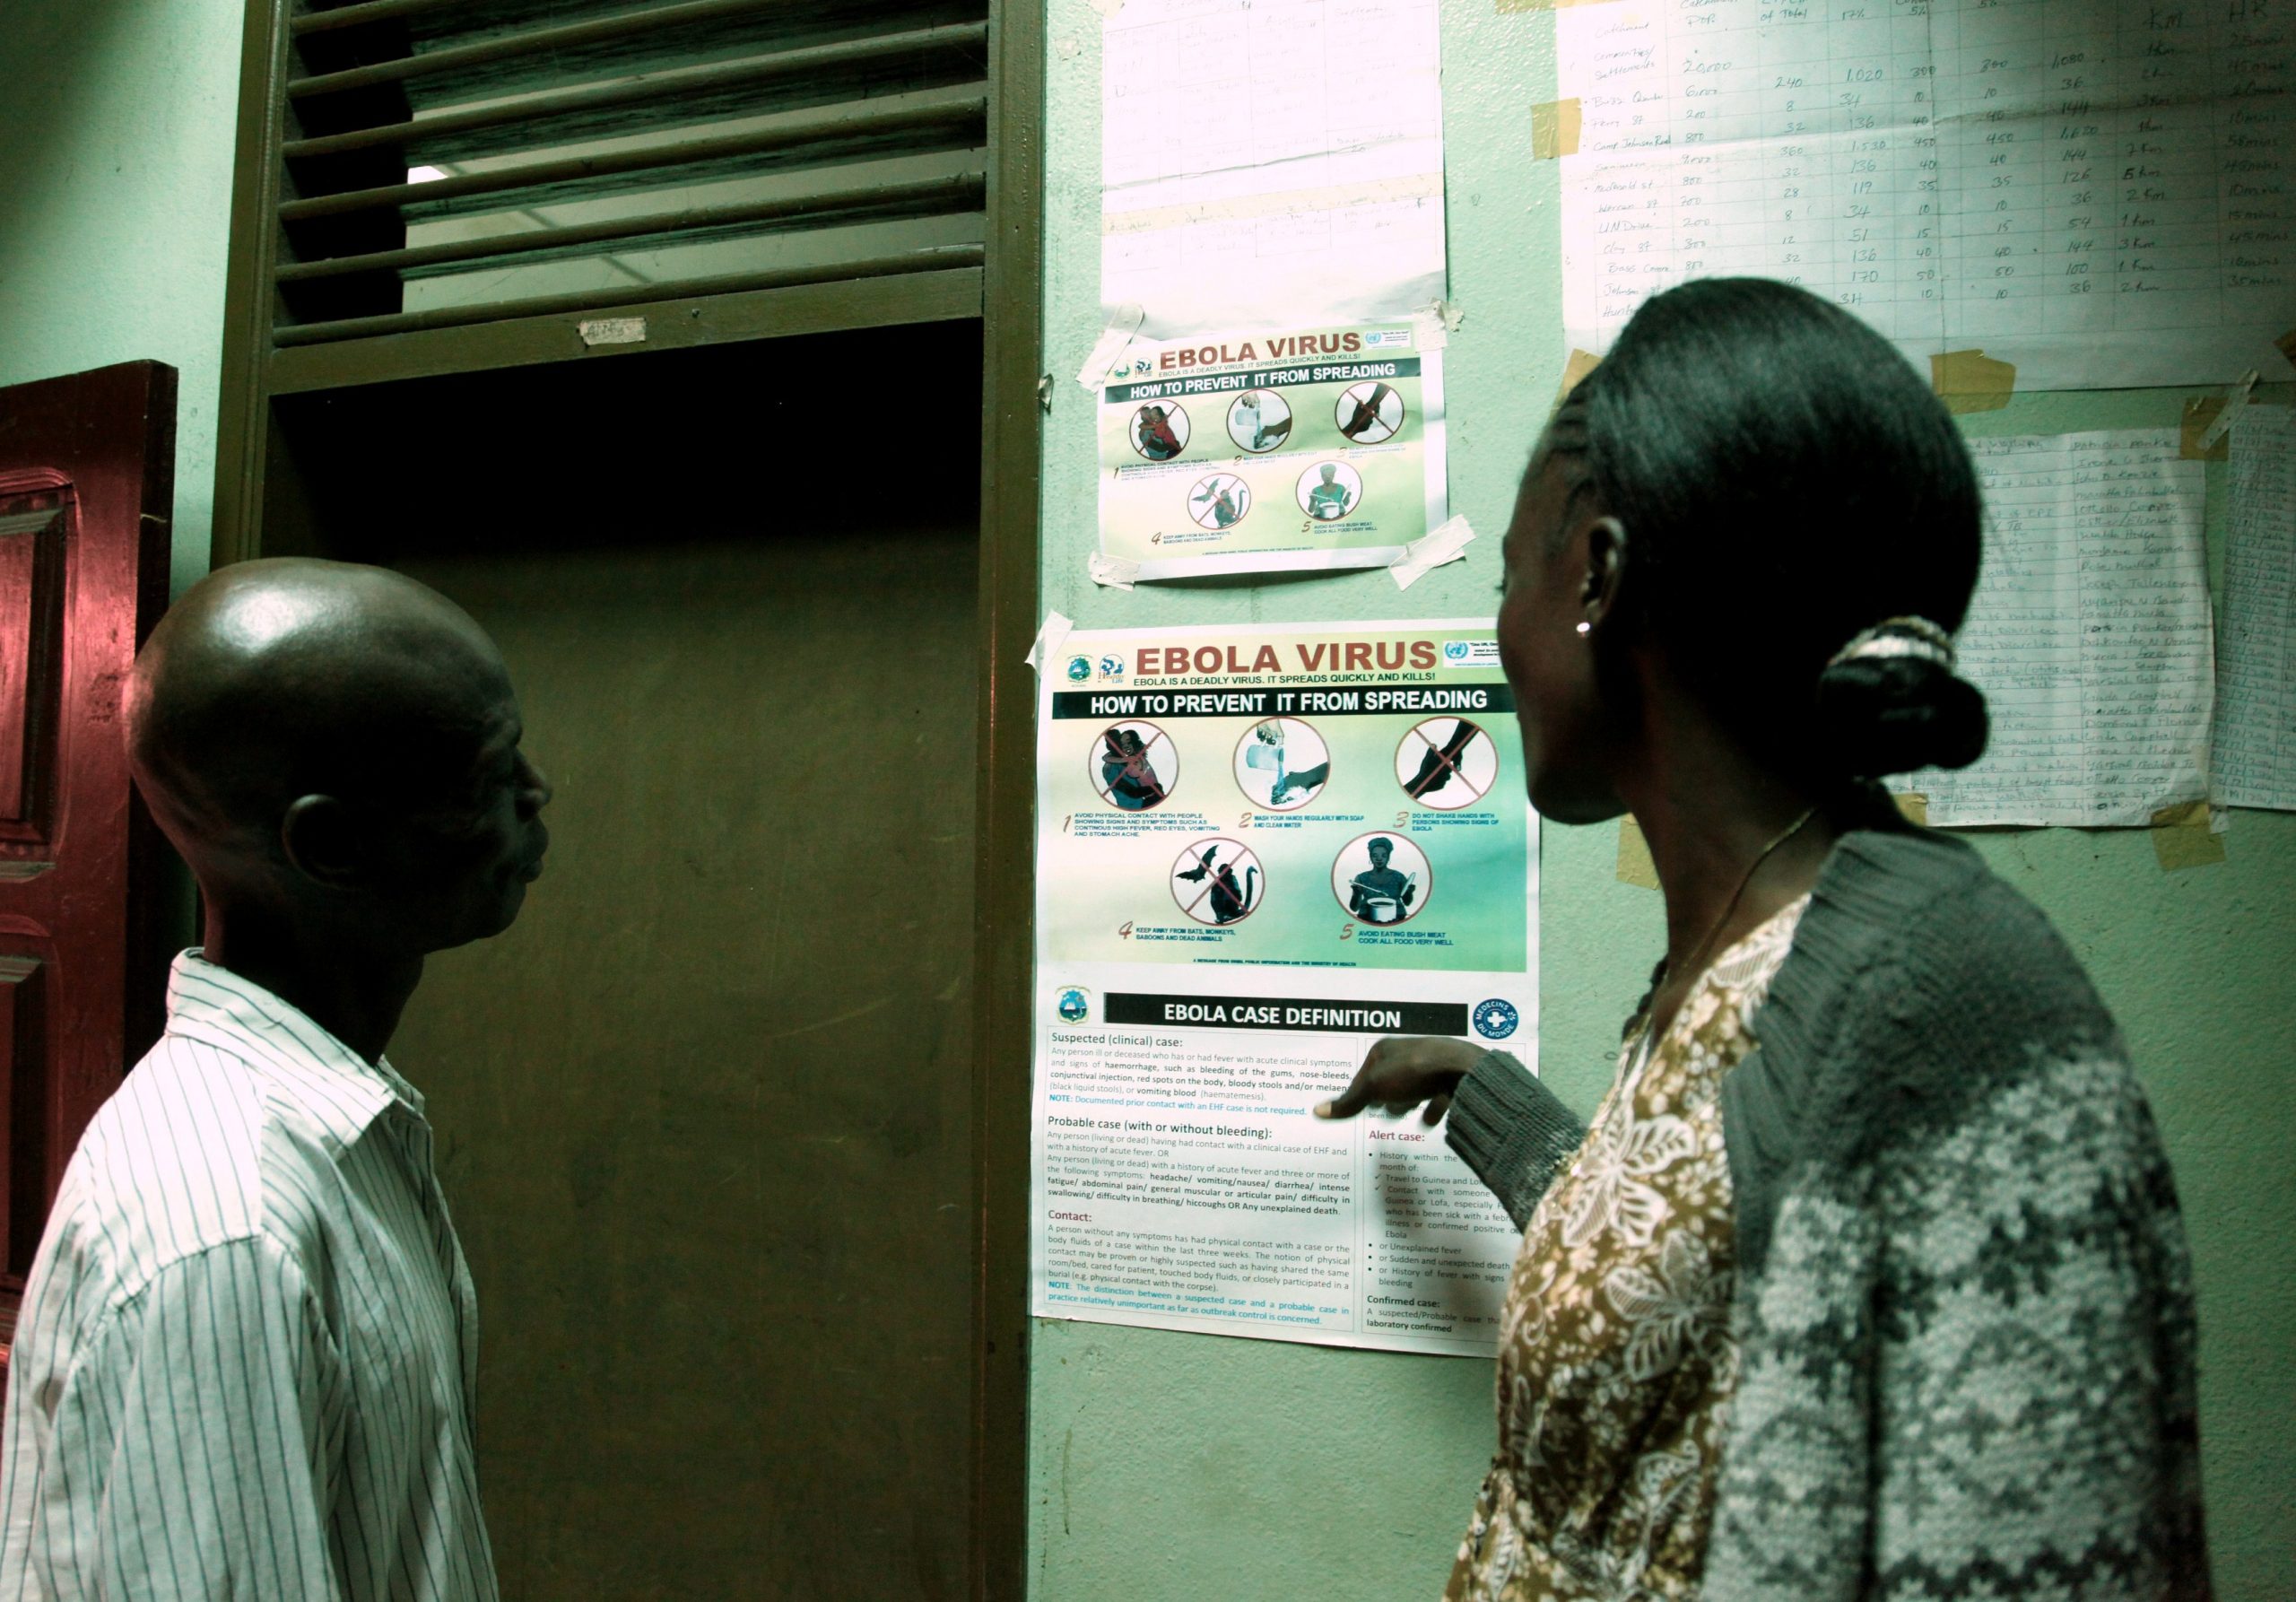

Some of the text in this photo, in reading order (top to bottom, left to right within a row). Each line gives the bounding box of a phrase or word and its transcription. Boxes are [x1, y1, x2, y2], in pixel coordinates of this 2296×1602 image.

[1775, 77, 1803, 89] 240
[1854, 182, 1872, 195] 119
[1852, 249, 1876, 263] 136
[1851, 270, 1878, 283] 170
[1160, 343, 1257, 370] EBOLA
[1266, 332, 1361, 360] VIRUS
[1159, 370, 1180, 378] EBOLA
[1290, 355, 1319, 363] QUICKLY
[1130, 362, 1396, 399] HOW TO PREVENT IT FROM SPREADING
[1136, 644, 1282, 675] EBOLA
[1295, 640, 1436, 673] VIRUS
[1134, 672, 1435, 687] EBOLA IS A DEADLY VIRUS. IT SPREADS QUICKLY AND KILLS!
[1091, 690, 1487, 715] HOW TO PREVENT IT FROM SPREADING
[1239, 812, 1252, 828] 2
[1393, 811, 1409, 828] 3
[1118, 921, 1133, 939] 4
[1339, 924, 1354, 940] 5
[1164, 1002, 1400, 1030] EBOLA CASE DEFINITION
[1477, 1023, 1515, 1038] DU MONDE
[1051, 1032, 1182, 1048] Suspected (clinical) case:
[1048, 1092, 1306, 1117] NOTE: Documented prior contact with an EHF case is not required.
[1048, 1114, 1271, 1140] Probable case (with or without bleeding):
[1369, 1129, 1425, 1144] Alert case:
[1048, 1188, 1340, 1217] swallowing/ difficulty in breathing/ hiccoughs OR Any unexplained death.
[1048, 1209, 1091, 1223] Contact:
[1367, 1294, 1439, 1309] Confirmed case:
[1367, 1319, 1452, 1334] laboratory confirmed
